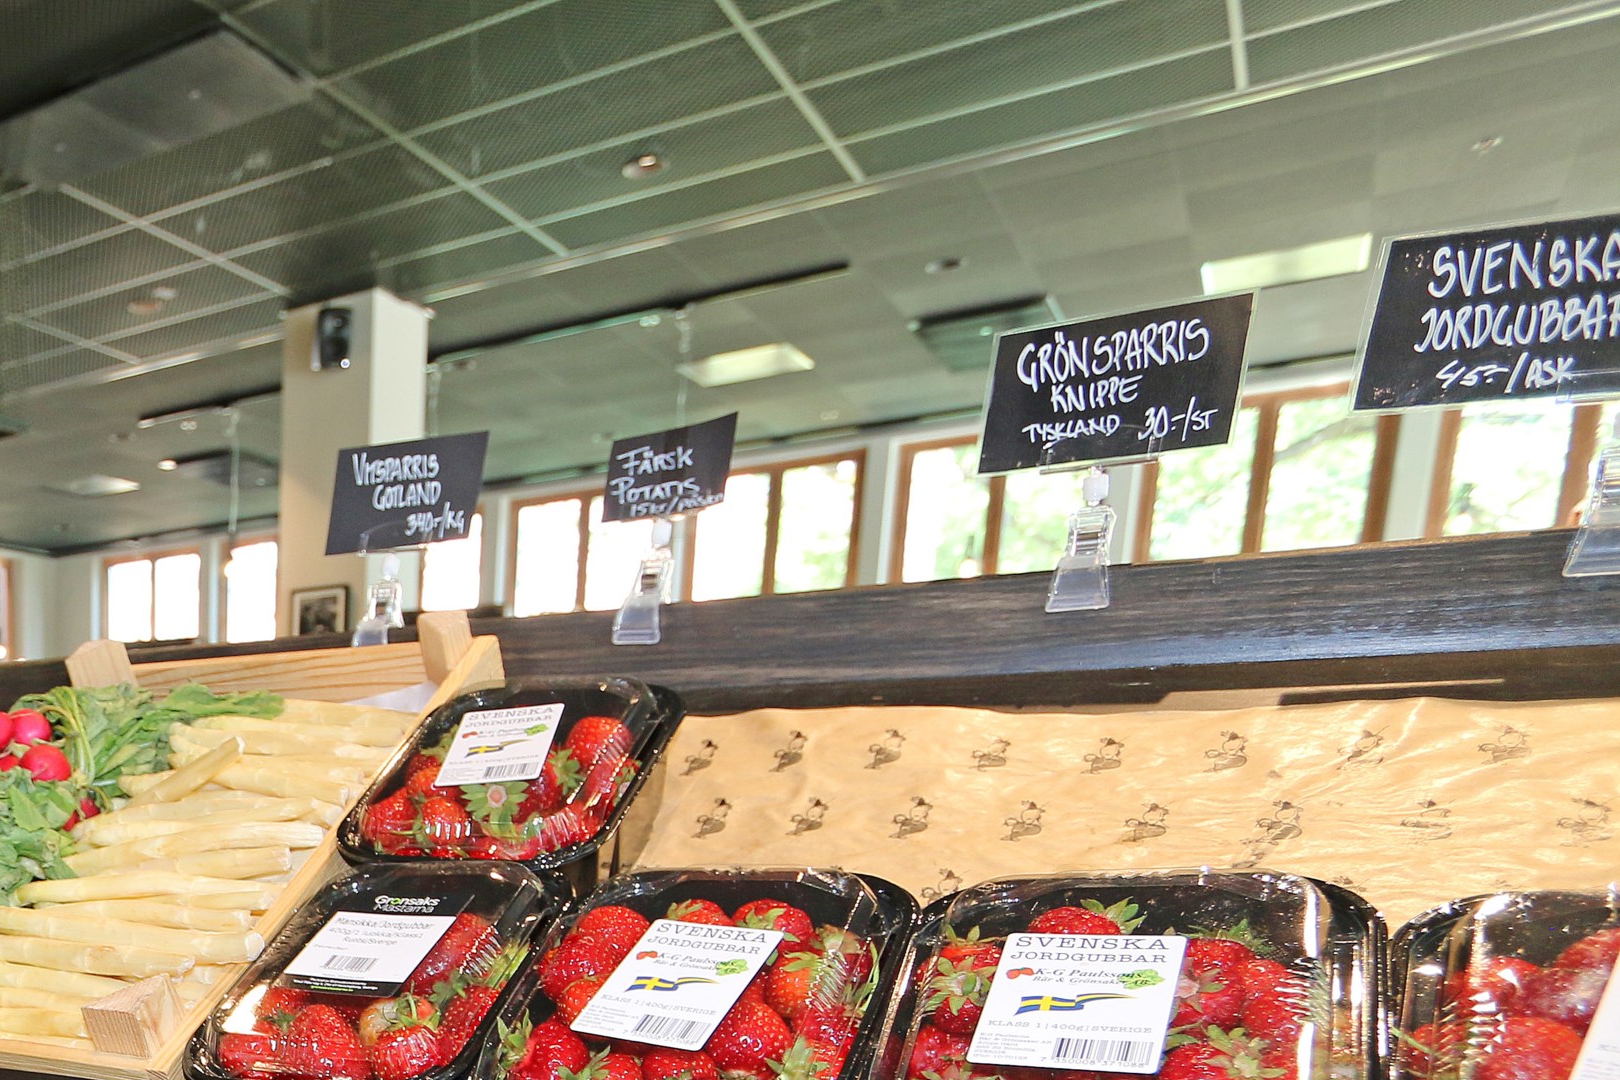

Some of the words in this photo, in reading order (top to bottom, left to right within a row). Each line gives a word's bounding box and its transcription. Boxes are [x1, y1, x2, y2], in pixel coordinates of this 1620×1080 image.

[1428, 232, 1620, 298] SVENSKA
[1016, 318, 1210, 393] GRÖNSPARRIS
[1050, 375, 1144, 414] KNIPPE
[1021, 414, 1121, 444] TYSKLAND
[351, 451, 441, 486] VITSPARRIS
[615, 445, 695, 477] FÄRSK
[371, 480, 442, 511] GOTLAND
[609, 476, 701, 505] POTATIS
[469, 706, 554, 721] SVENSKA
[646, 935, 761, 955] JORDGUBBAR
[656, 922, 768, 943] SVENSKA
[1015, 935, 1170, 951] SVENSKA
[1009, 950, 1168, 964] JORDGUBBAR
[1034, 967, 1066, 978] K-G
[987, 1019, 1030, 1029] KLASS
